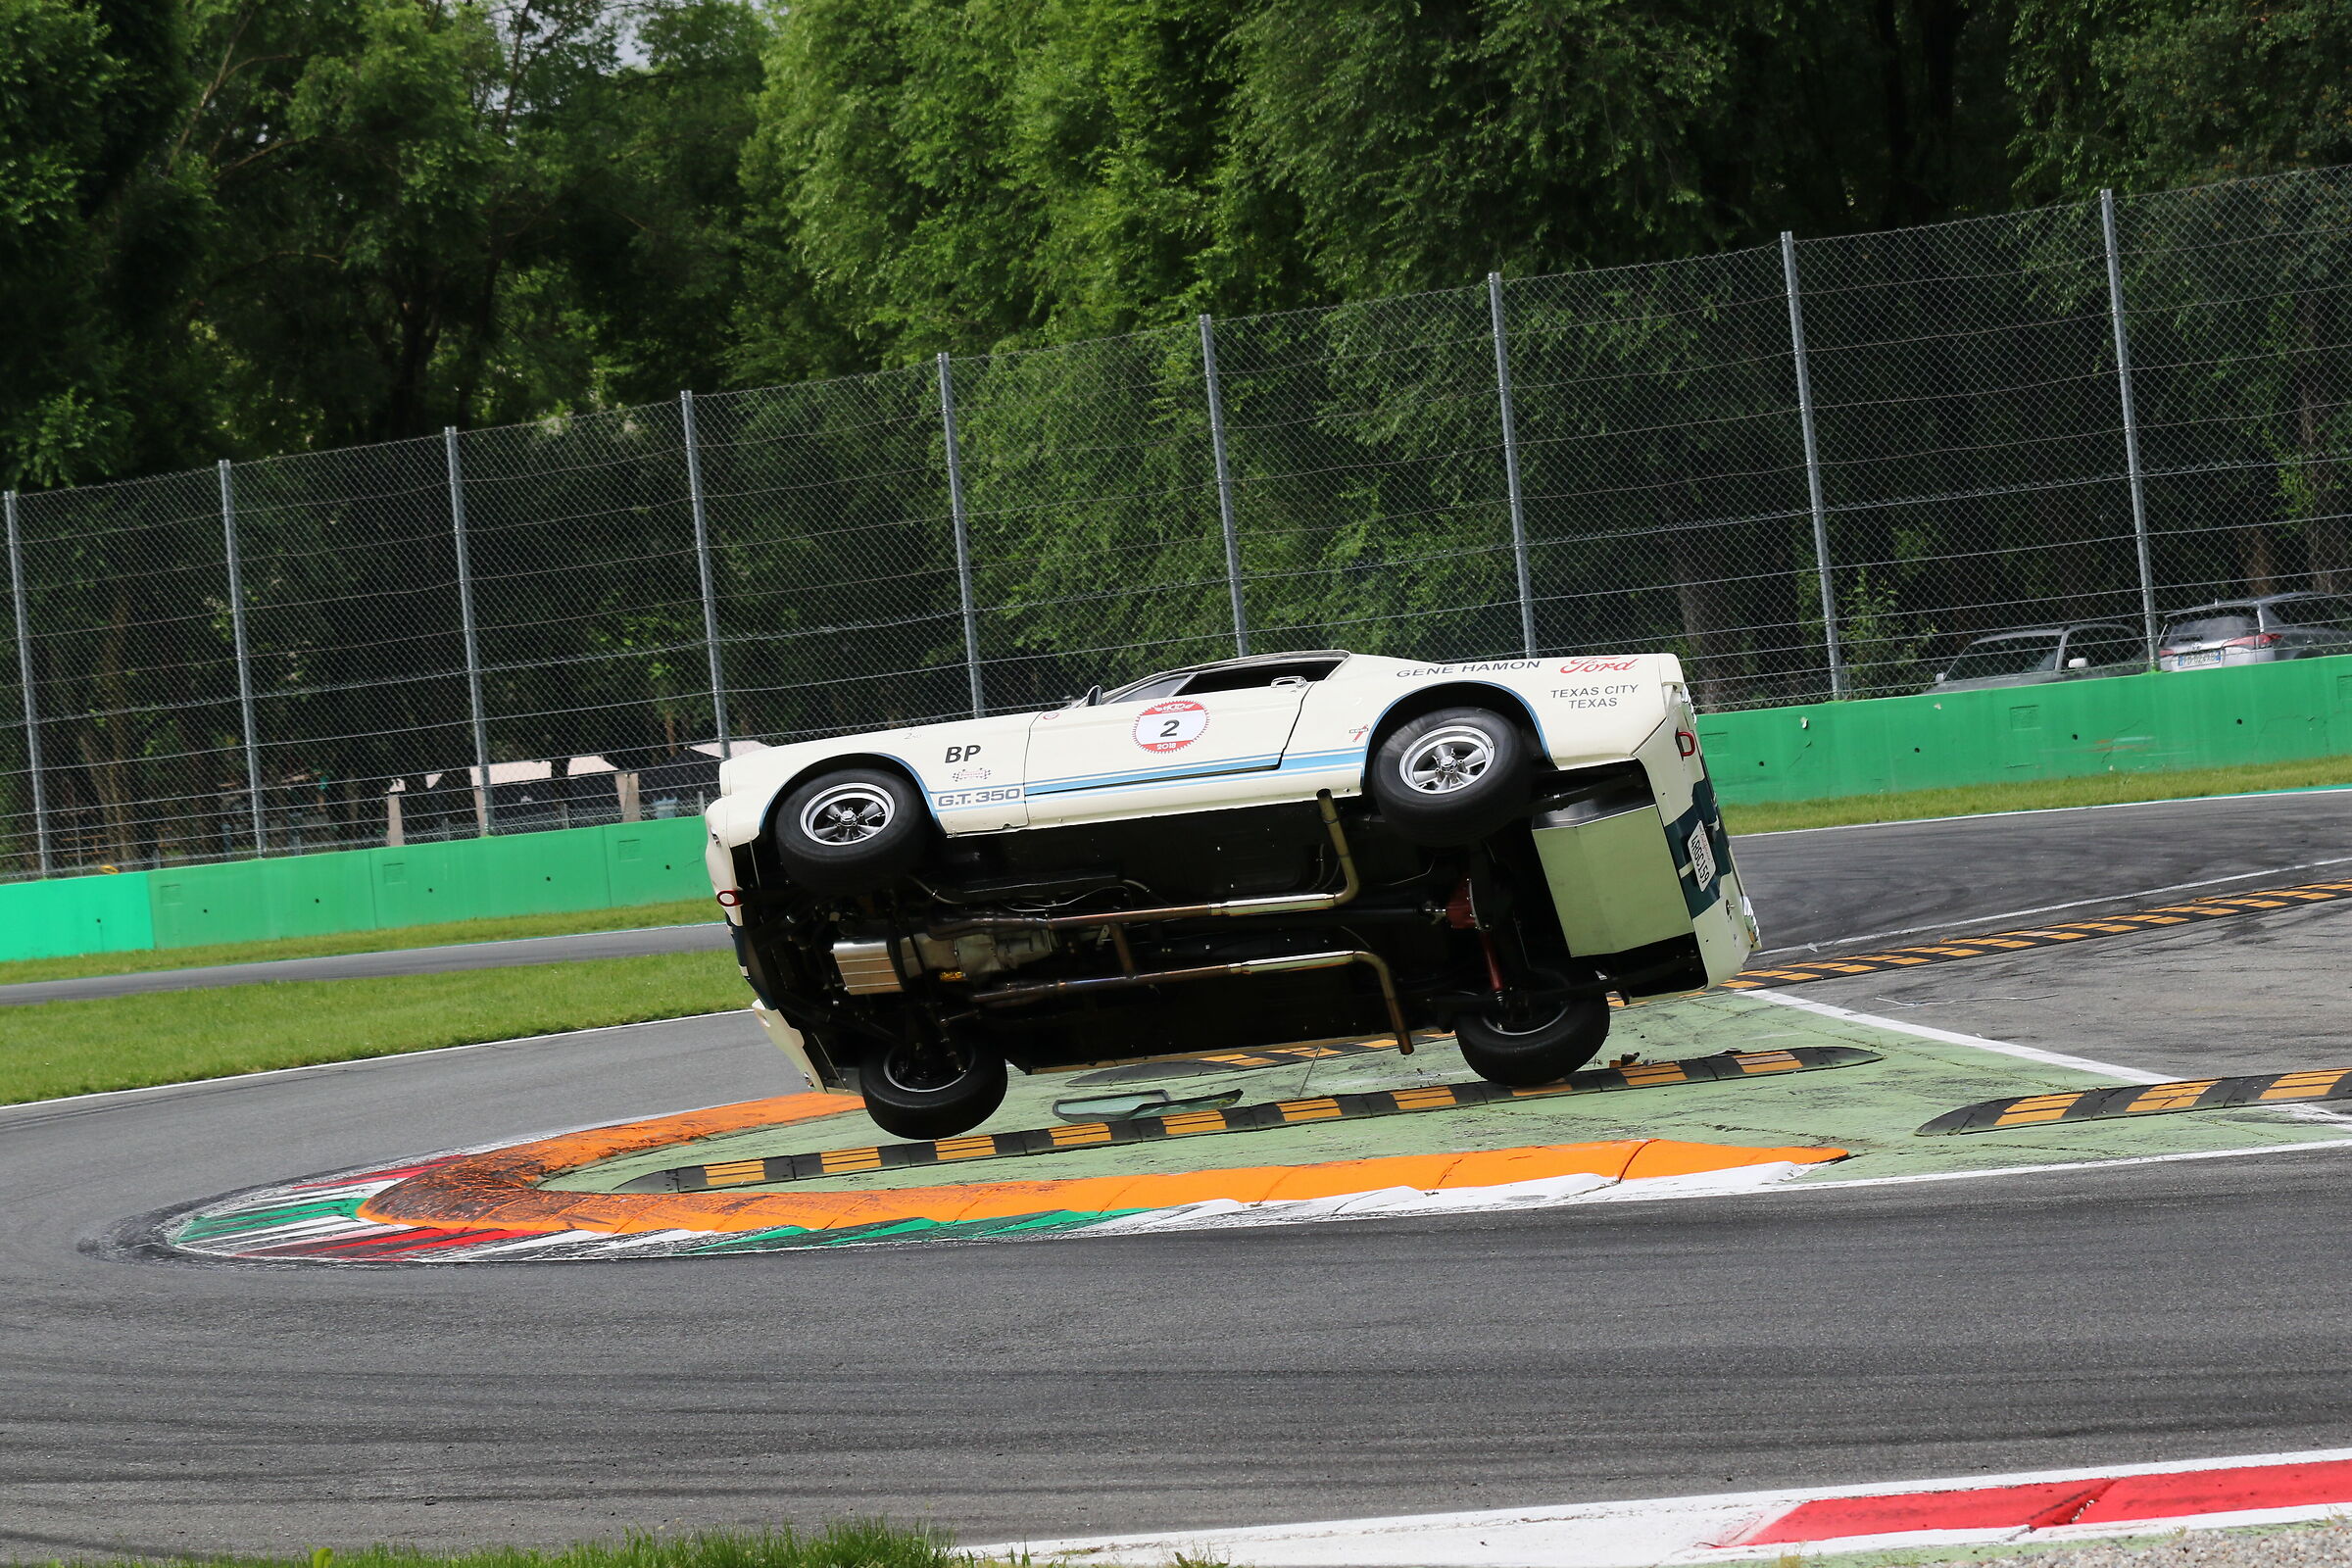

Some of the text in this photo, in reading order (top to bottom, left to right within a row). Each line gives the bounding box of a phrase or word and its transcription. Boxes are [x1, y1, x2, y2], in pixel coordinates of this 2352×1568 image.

[1396, 660, 1541, 678] GENE HAMON
[1560, 657, 1640, 674] Ford
[1550, 684, 1640, 699] TEXAS CITY
[1568, 697, 1618, 710] TEXAS
[1159, 719, 1180, 737] 2
[945, 745, 981, 763] BP
[938, 788, 1021, 808] G.T. 350
